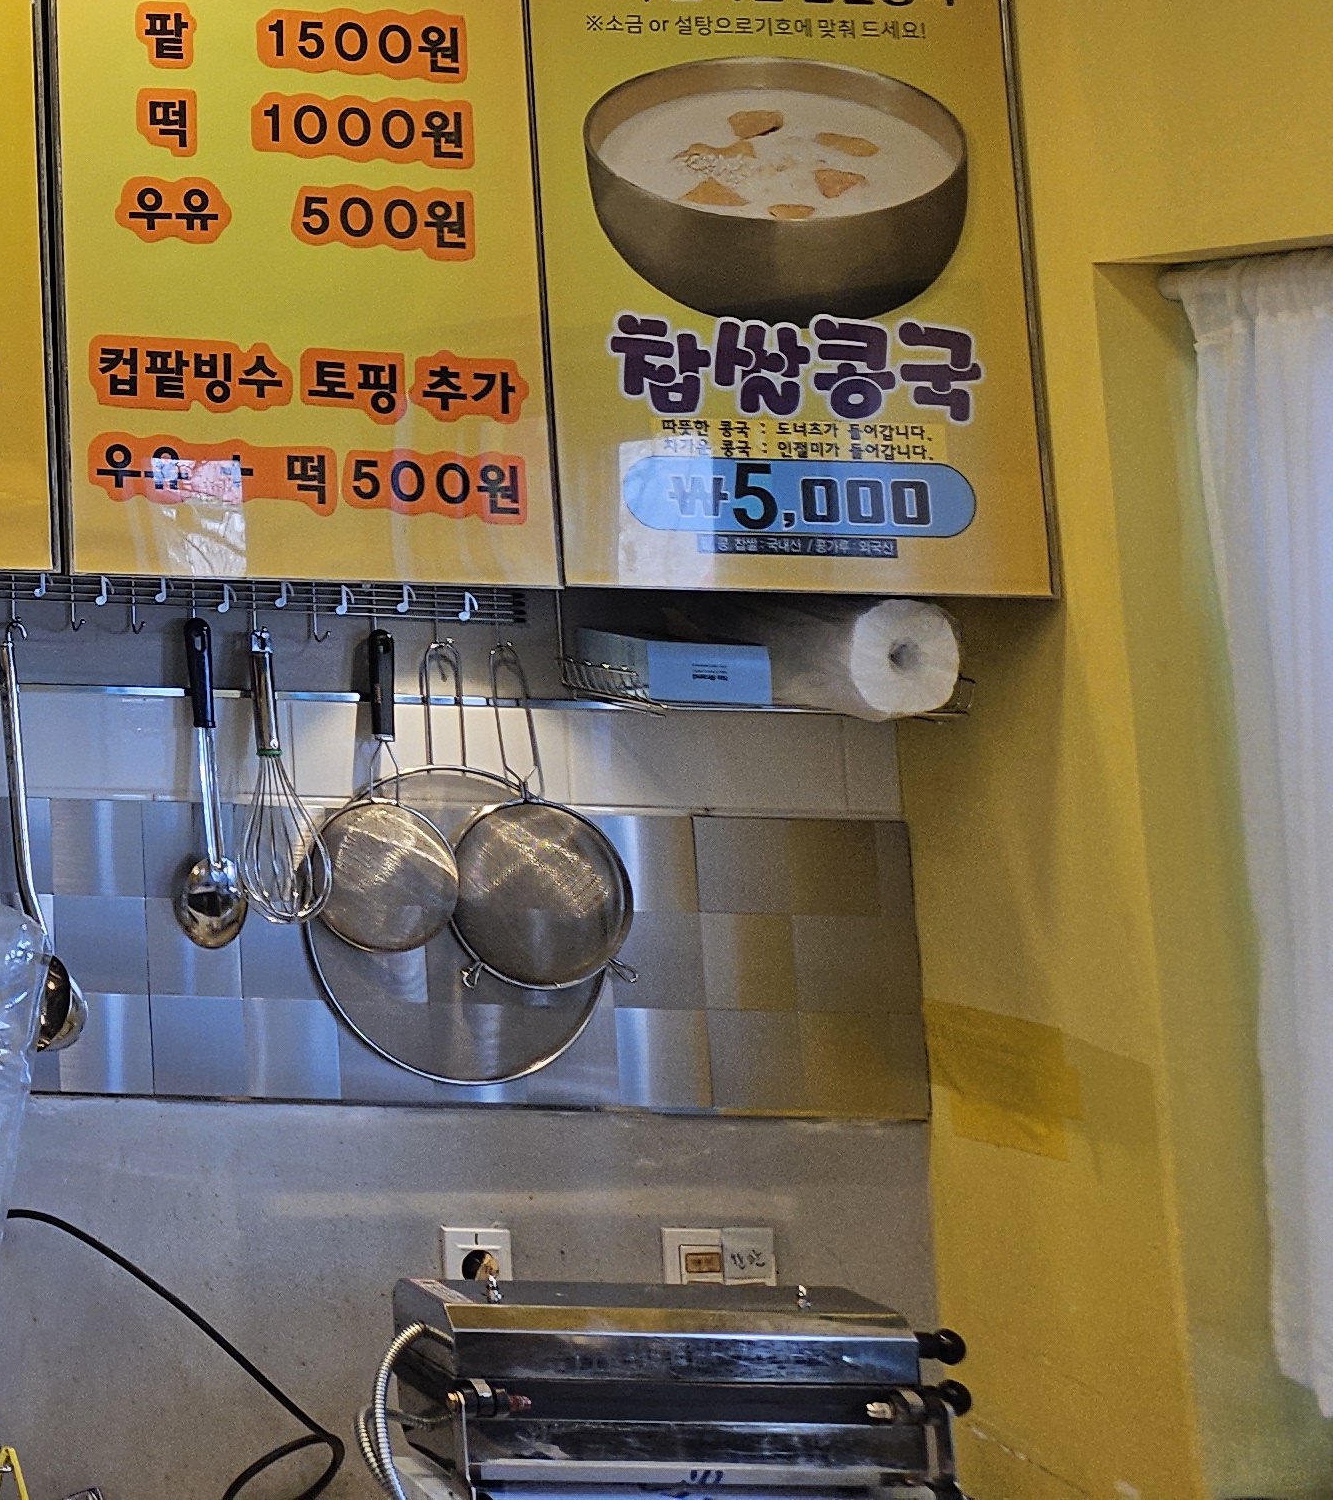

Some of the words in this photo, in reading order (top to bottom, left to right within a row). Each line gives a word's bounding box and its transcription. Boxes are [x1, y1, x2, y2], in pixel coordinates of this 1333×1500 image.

[144, 13, 188, 60] 팥
[268, 19, 460, 74] 1500원
[649, 19, 669, 32] or
[818, 19, 856, 39] 맞춰
[861, 20, 926, 40] 드세요!
[148, 100, 187, 148] 떡
[263, 103, 464, 159] 1000원
[128, 187, 219, 231] 우유
[302, 195, 467, 249] 500원
[99, 347, 283, 403] 컵팥빙수
[308, 360, 397, 415] 토핑
[422, 366, 516, 414] 추가
[609, 313, 983, 423] 찹쌀콩국
[661, 419, 710, 437] 따뜻한
[718, 420, 751, 439] 콩국
[776, 422, 838, 439] 도너츠가
[720, 440, 752, 458] 콩국
[778, 441, 840, 459] 인절미가
[286, 454, 326, 505] 떡
[352, 459, 520, 516] 500원
